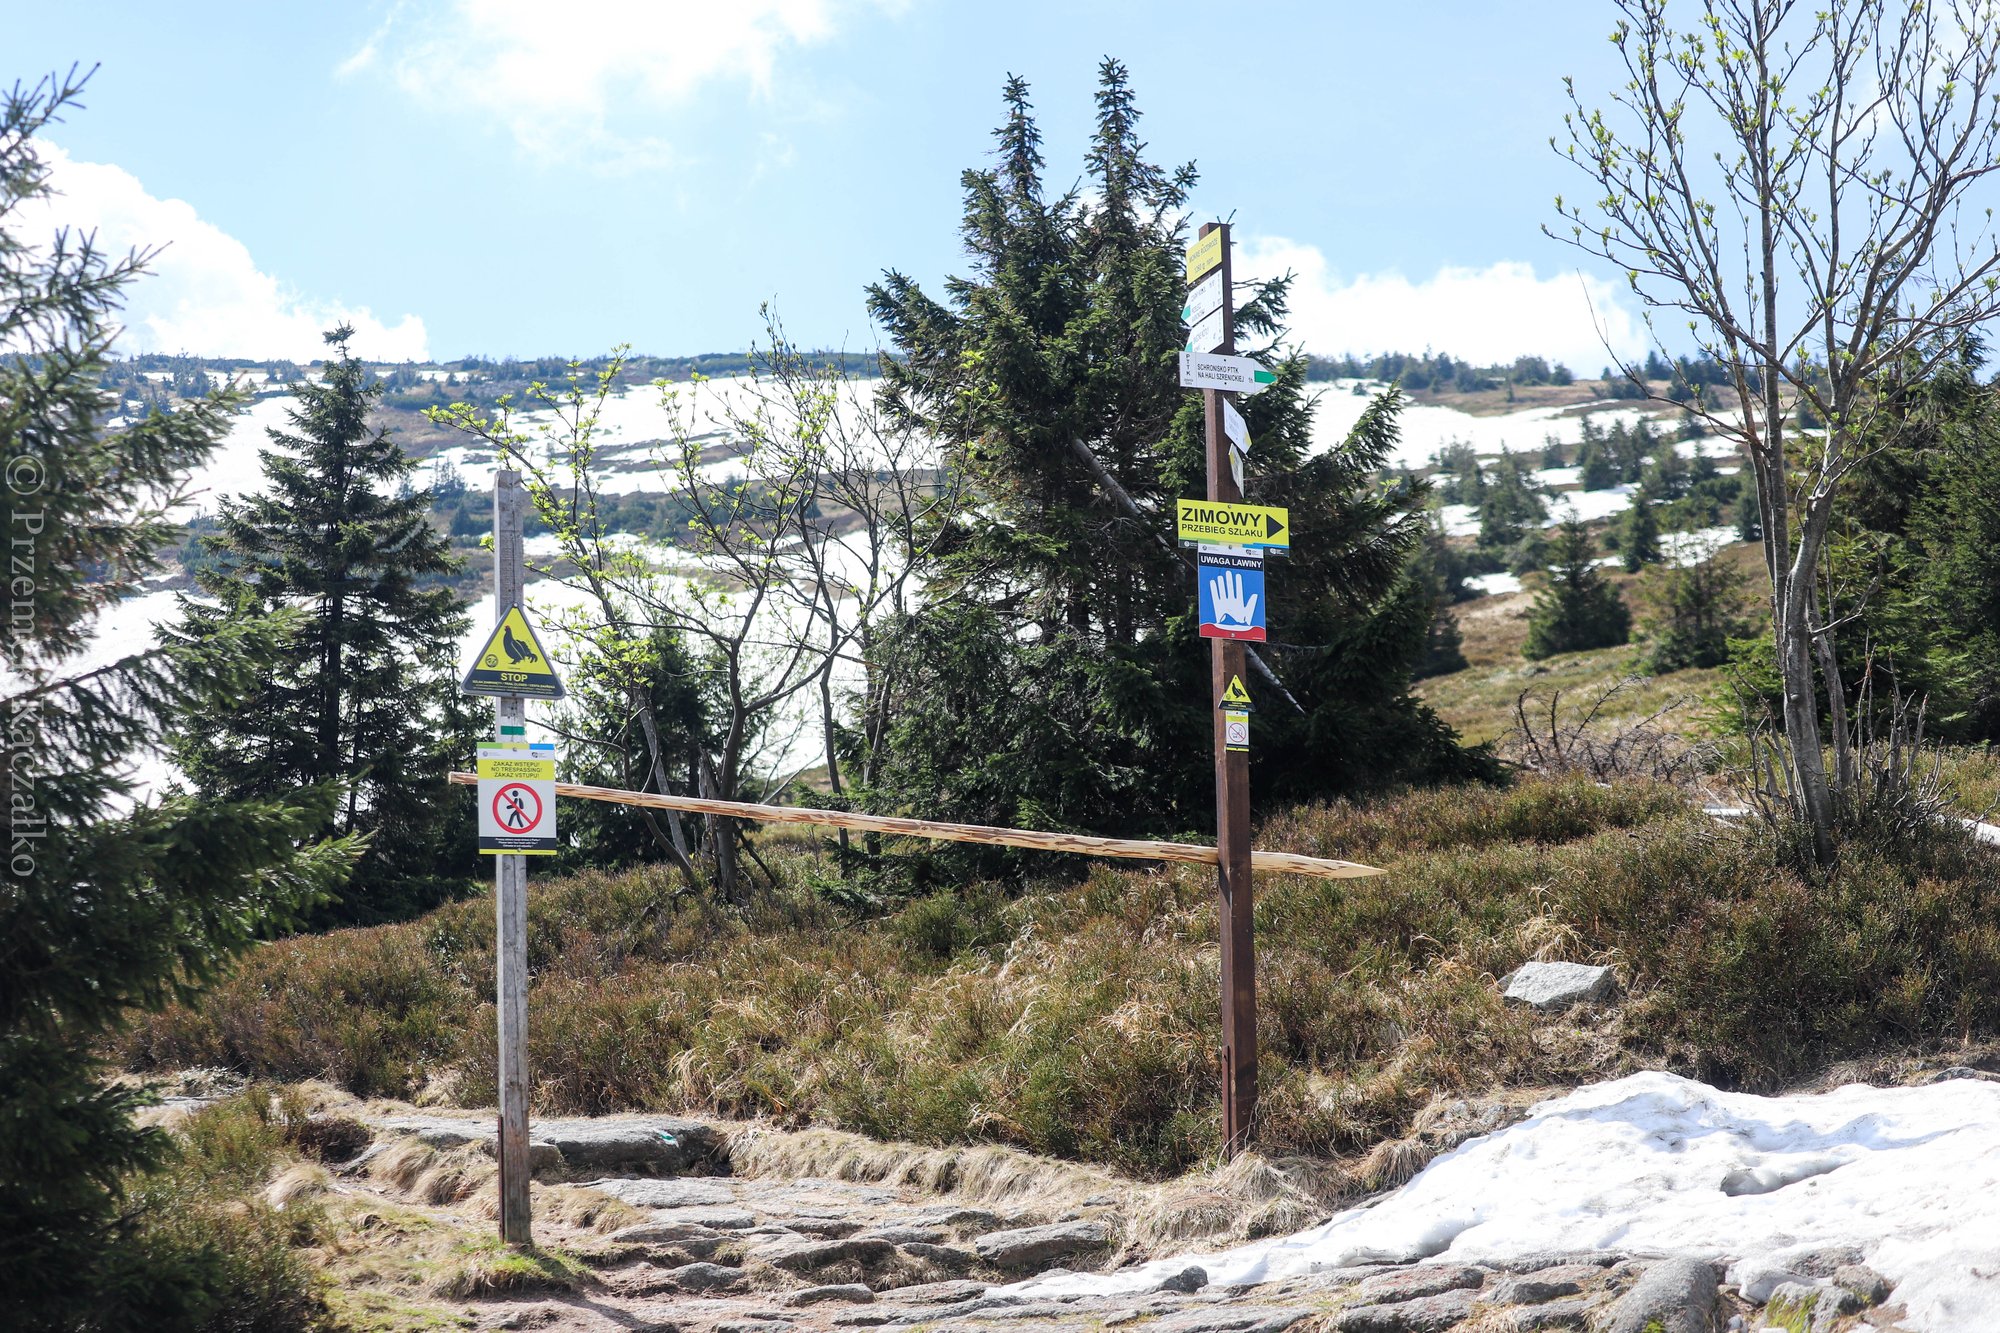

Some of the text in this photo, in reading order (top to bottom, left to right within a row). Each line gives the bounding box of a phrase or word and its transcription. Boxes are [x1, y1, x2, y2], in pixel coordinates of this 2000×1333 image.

[1197, 363, 1227, 373] SCHRONISKO
[1181, 507, 1261, 527] ZIMOWY
[1181, 524, 1263, 538] PRZEBIEG SZLAKU
[1200, 555, 1262, 568] UWAGA LAWINY
[500, 672, 528, 682] STOP
